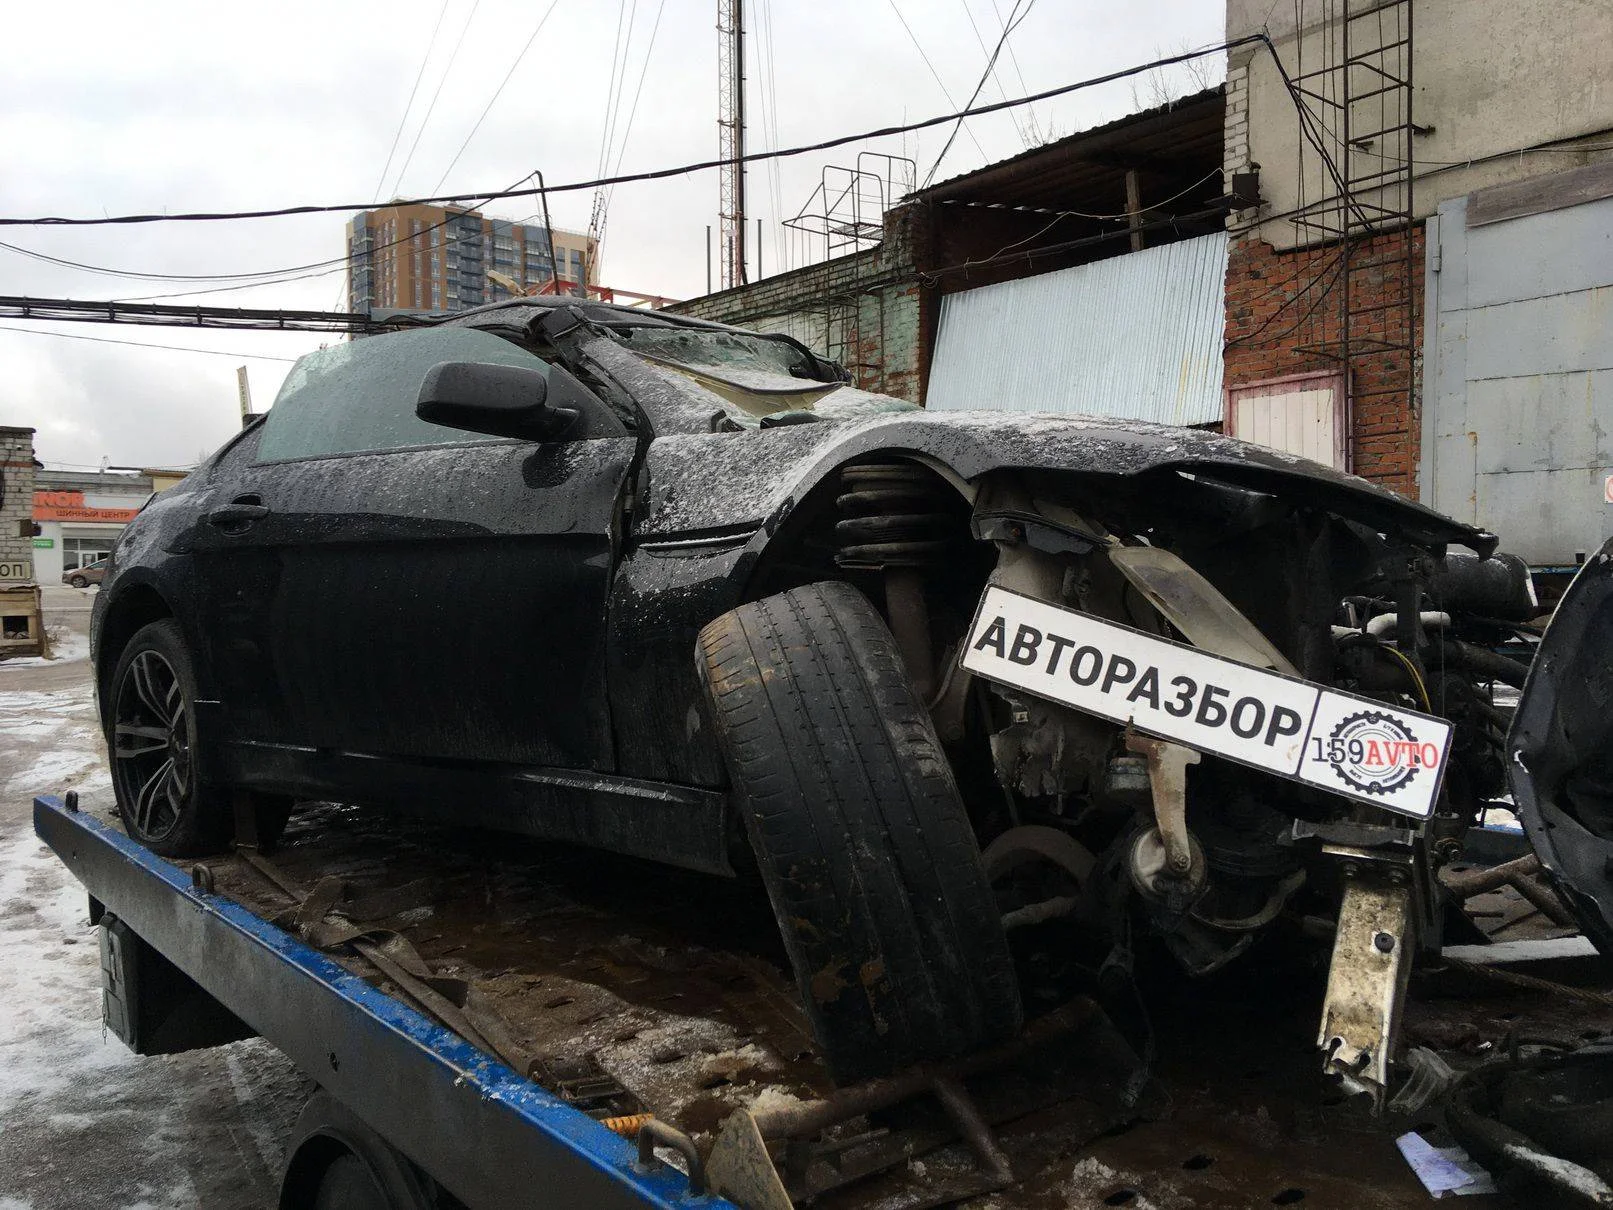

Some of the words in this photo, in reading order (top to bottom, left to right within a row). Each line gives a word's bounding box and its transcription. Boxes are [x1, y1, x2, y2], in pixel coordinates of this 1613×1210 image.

[56, 510, 99, 518] ШИННЫЙ
[101, 511, 130, 519] ЦЕНТР
[973, 616, 1303, 747] АВТОРАЗБОР
[1312, 737, 1439, 769] 159AVTO
